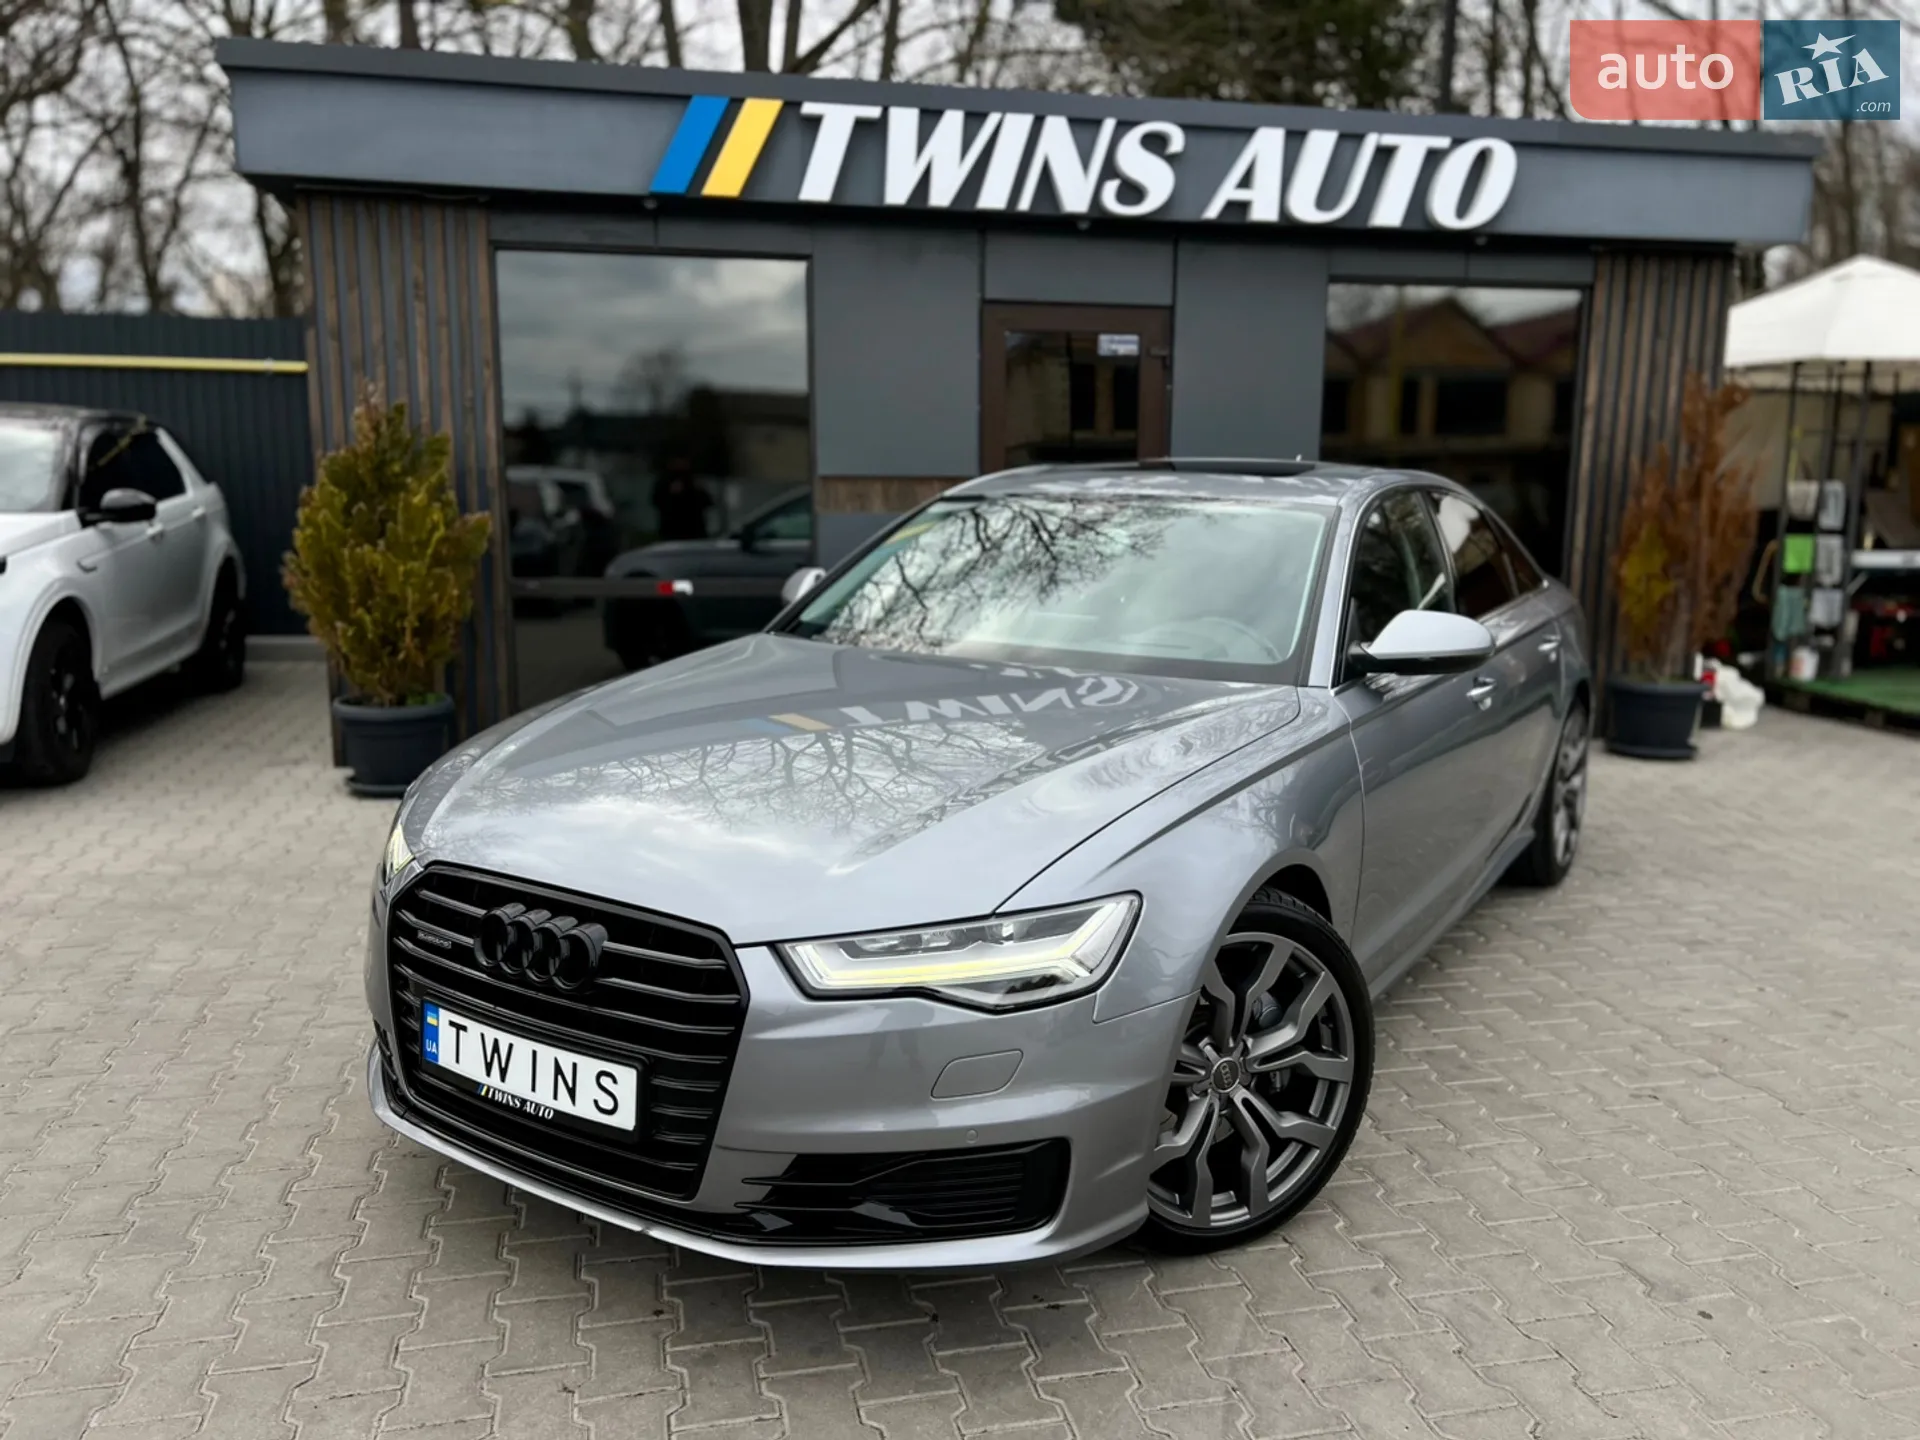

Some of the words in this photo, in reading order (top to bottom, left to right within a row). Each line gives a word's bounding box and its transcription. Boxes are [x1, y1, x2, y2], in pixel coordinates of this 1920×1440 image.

[798, 101, 1186, 216] TWINS
[1200, 126, 1518, 230] AUTO
[426, 1041, 438, 1054] UA
[488, 1087, 521, 1108] TWINS
[523, 1101, 554, 1120] AUTO
